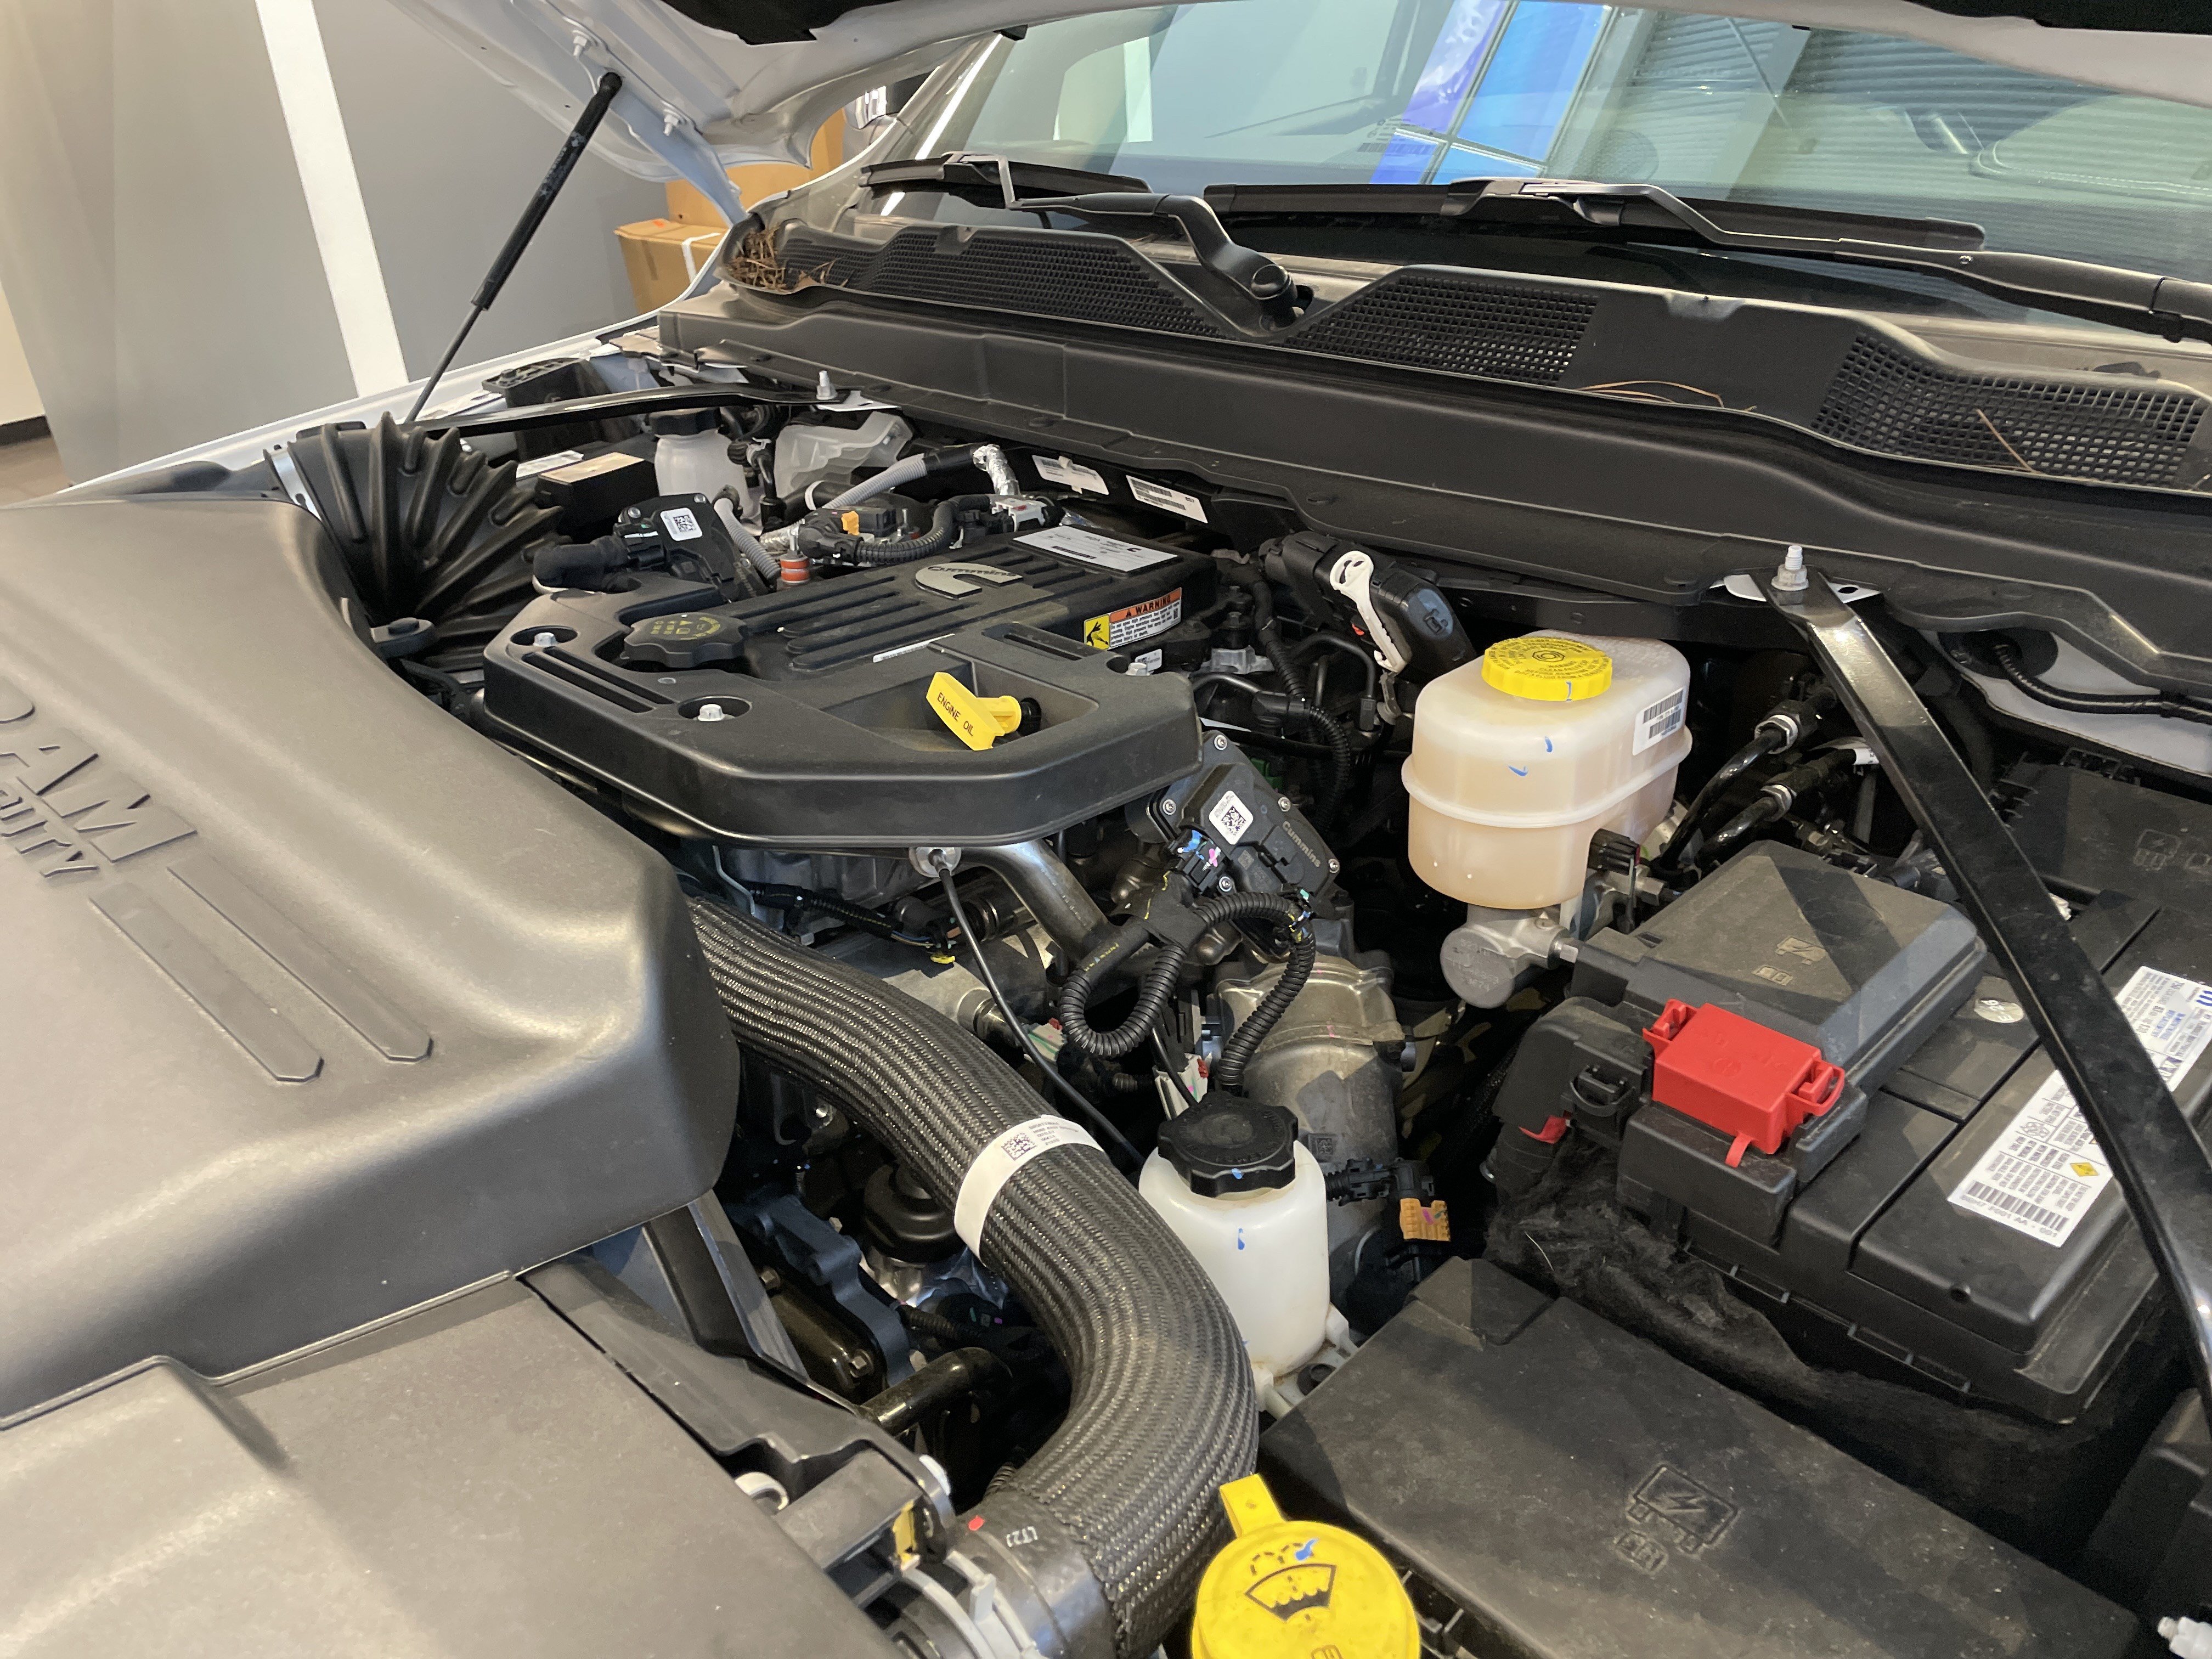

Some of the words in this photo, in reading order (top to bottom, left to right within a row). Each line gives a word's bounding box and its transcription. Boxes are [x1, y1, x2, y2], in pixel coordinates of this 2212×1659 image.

[1135, 595, 1171, 614] WARNING
[937, 691, 961, 722] ENGINE
[963, 720, 974, 737] OIL
[1283, 821, 1321, 867] Cummins
